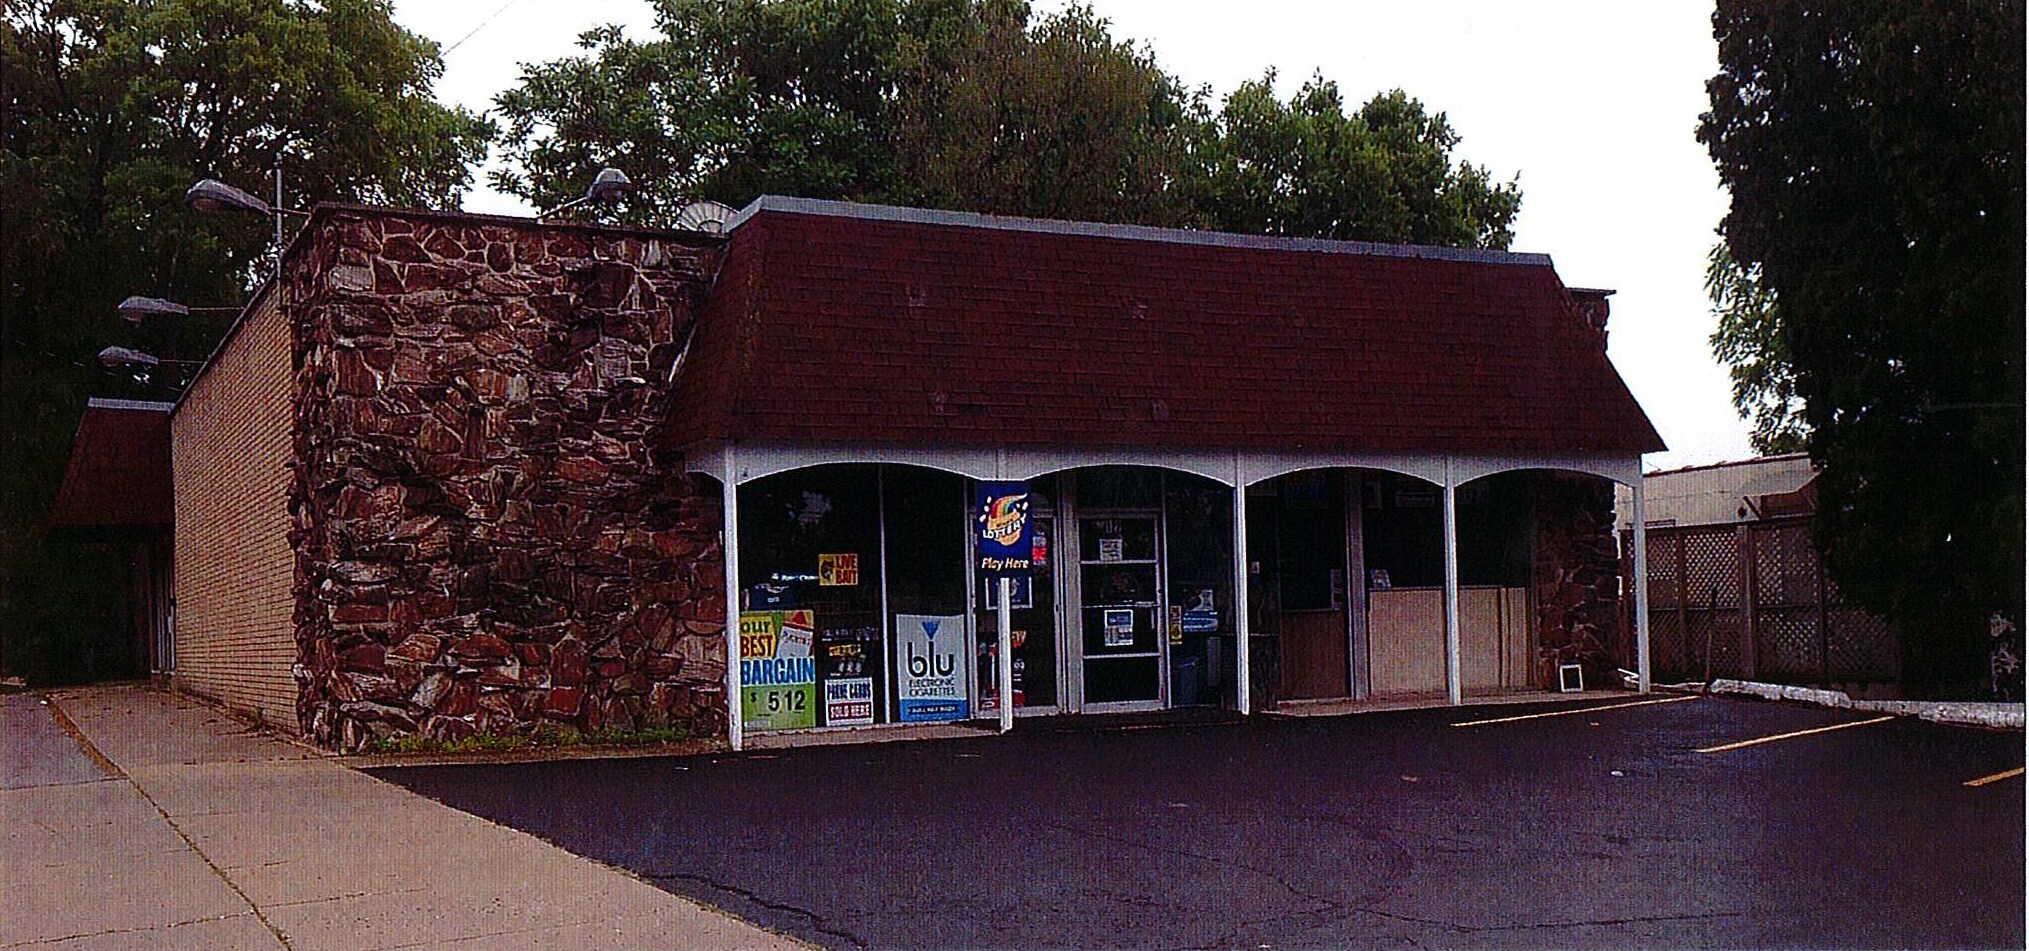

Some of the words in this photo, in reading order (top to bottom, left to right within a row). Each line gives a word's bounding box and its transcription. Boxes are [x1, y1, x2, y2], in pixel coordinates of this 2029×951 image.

[982, 513, 1027, 539] LOTTERY
[835, 554, 857, 570] LIVE
[981, 557, 1004, 571] Play
[1005, 557, 1030, 569] Here
[835, 569, 857, 585] BAIT
[741, 635, 773, 657] BEST
[907, 641, 955, 677] blu
[741, 658, 815, 685] BARGAIN
[909, 679, 955, 688] ELECTRONIC
[909, 687, 955, 697] CIGARETTES
[830, 705, 849, 718] SOLD
[850, 704, 870, 716] HERE
